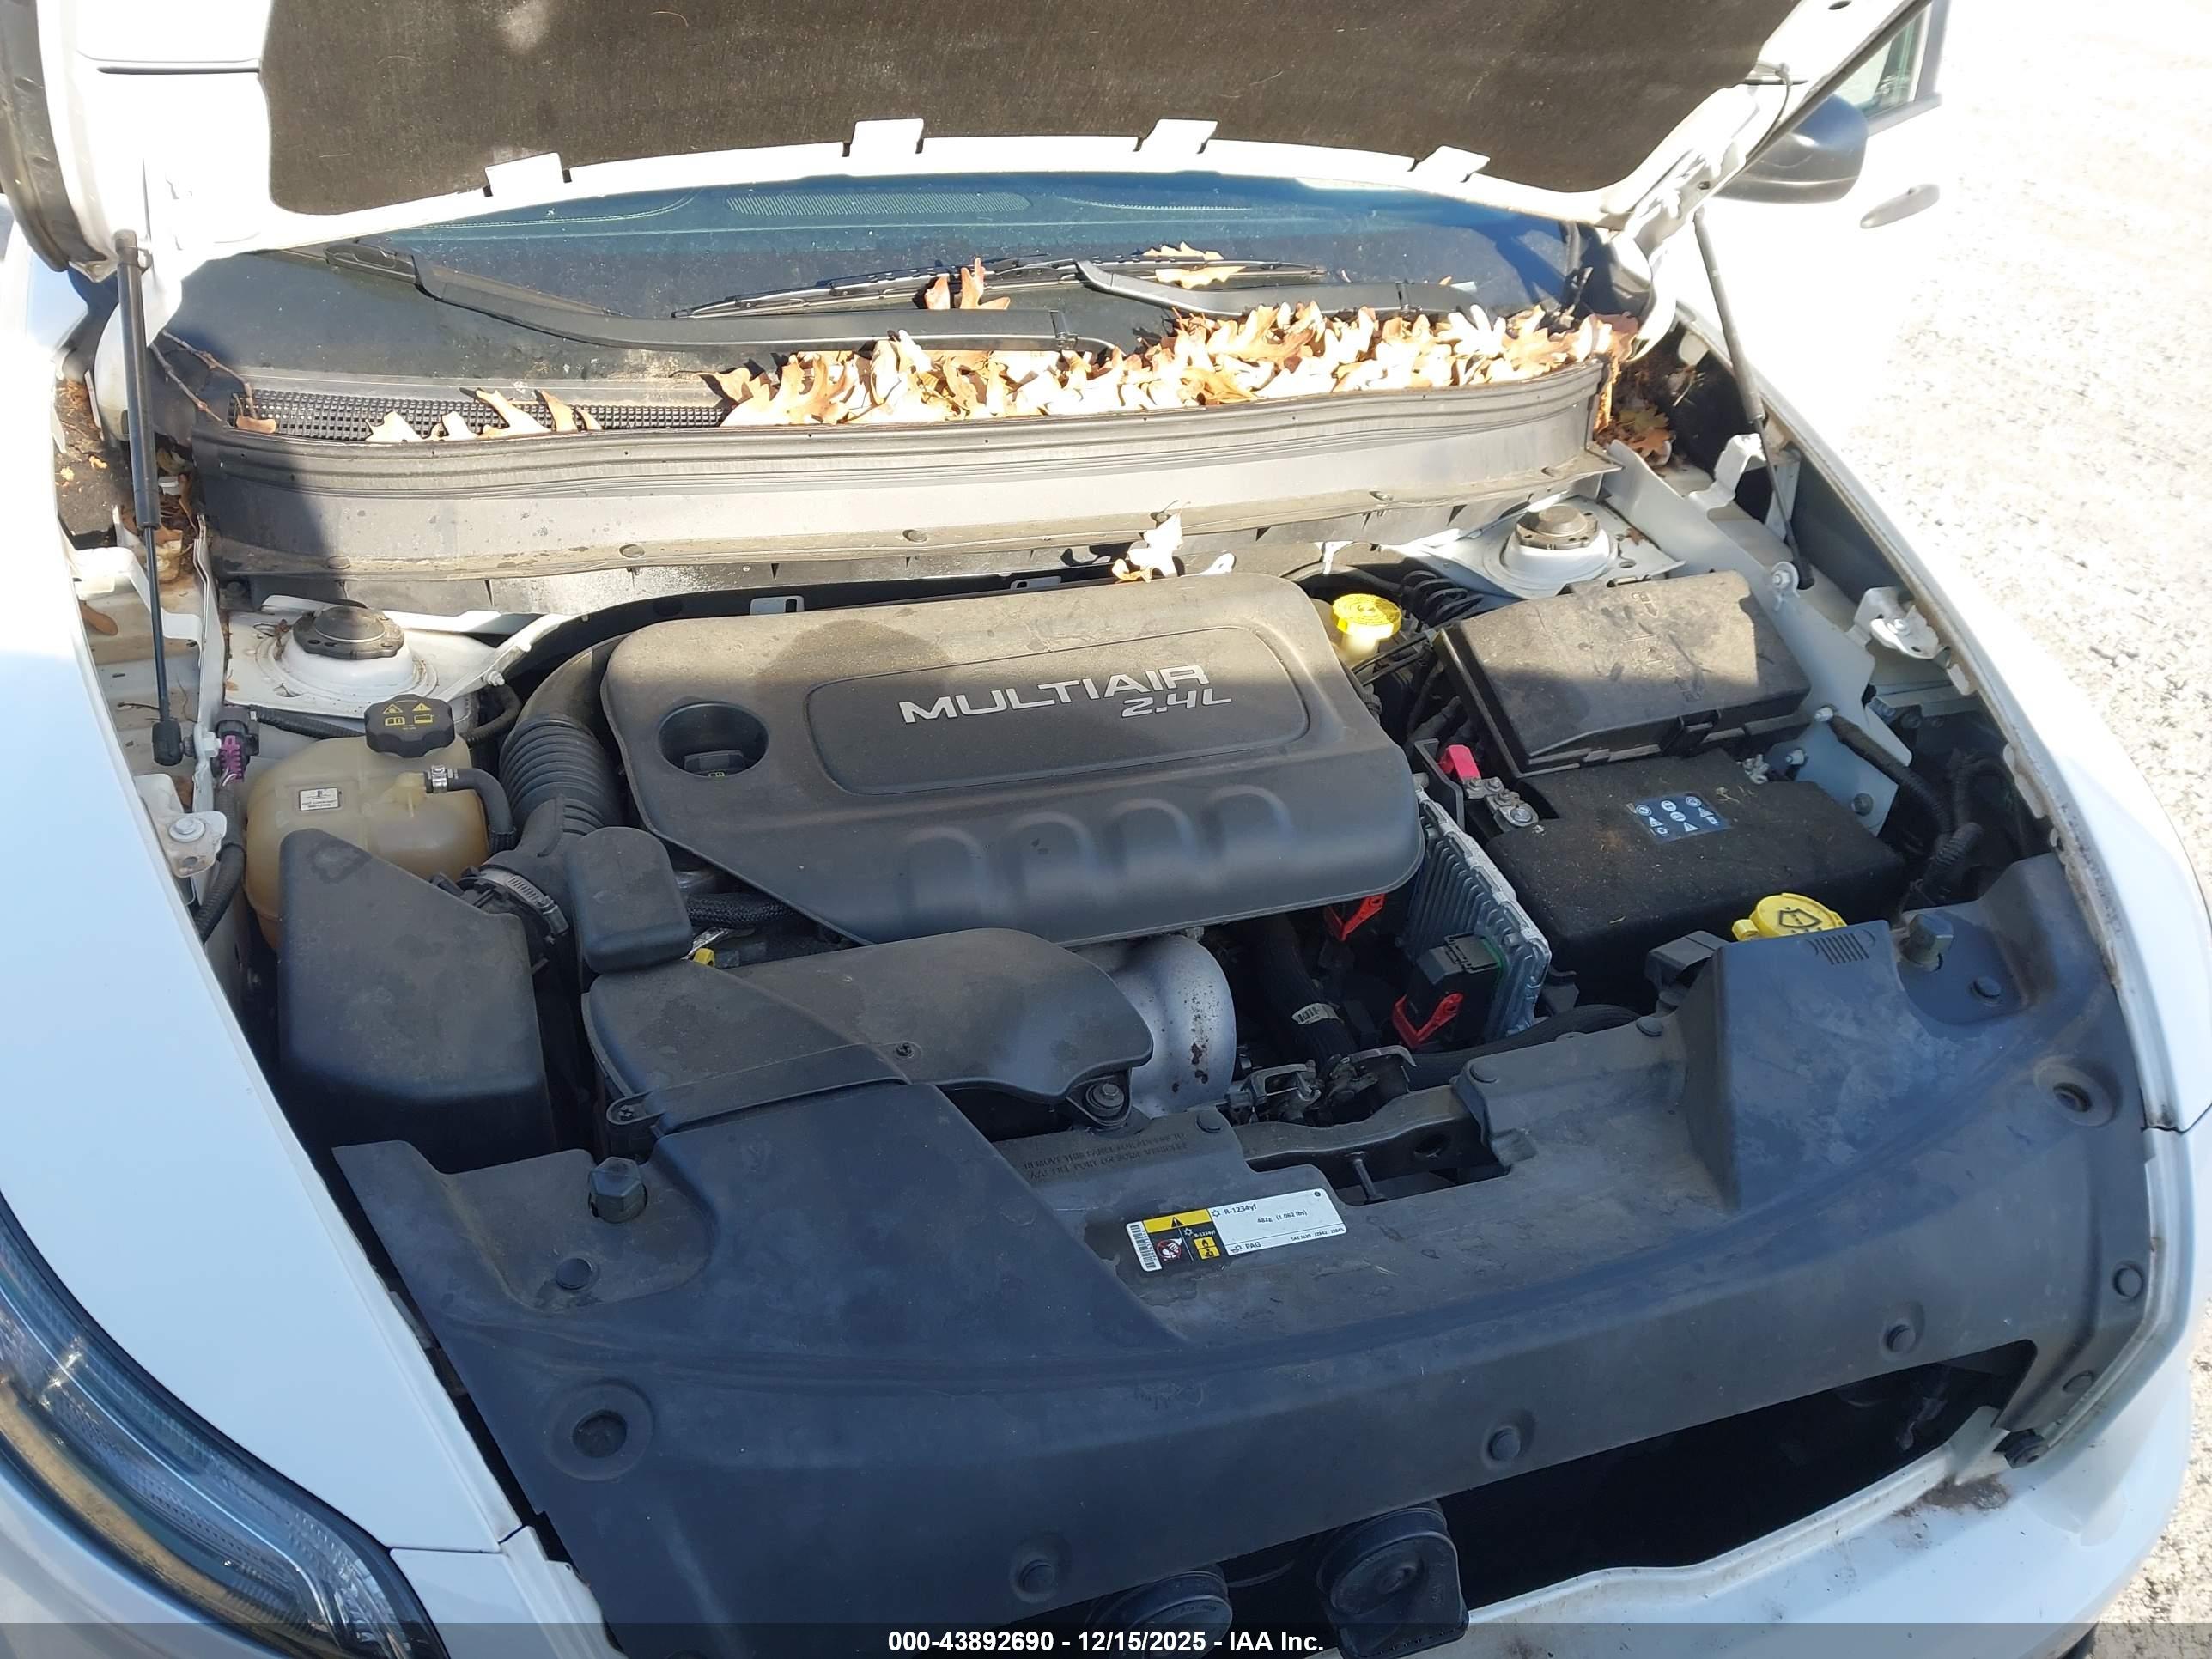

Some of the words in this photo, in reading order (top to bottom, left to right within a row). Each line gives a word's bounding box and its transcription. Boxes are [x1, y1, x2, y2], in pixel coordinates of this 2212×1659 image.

[898, 665, 1210, 724] MULTIAIR
[1121, 689, 1232, 718] 2.4L
[1224, 1203, 1256, 1215] R-1234yf
